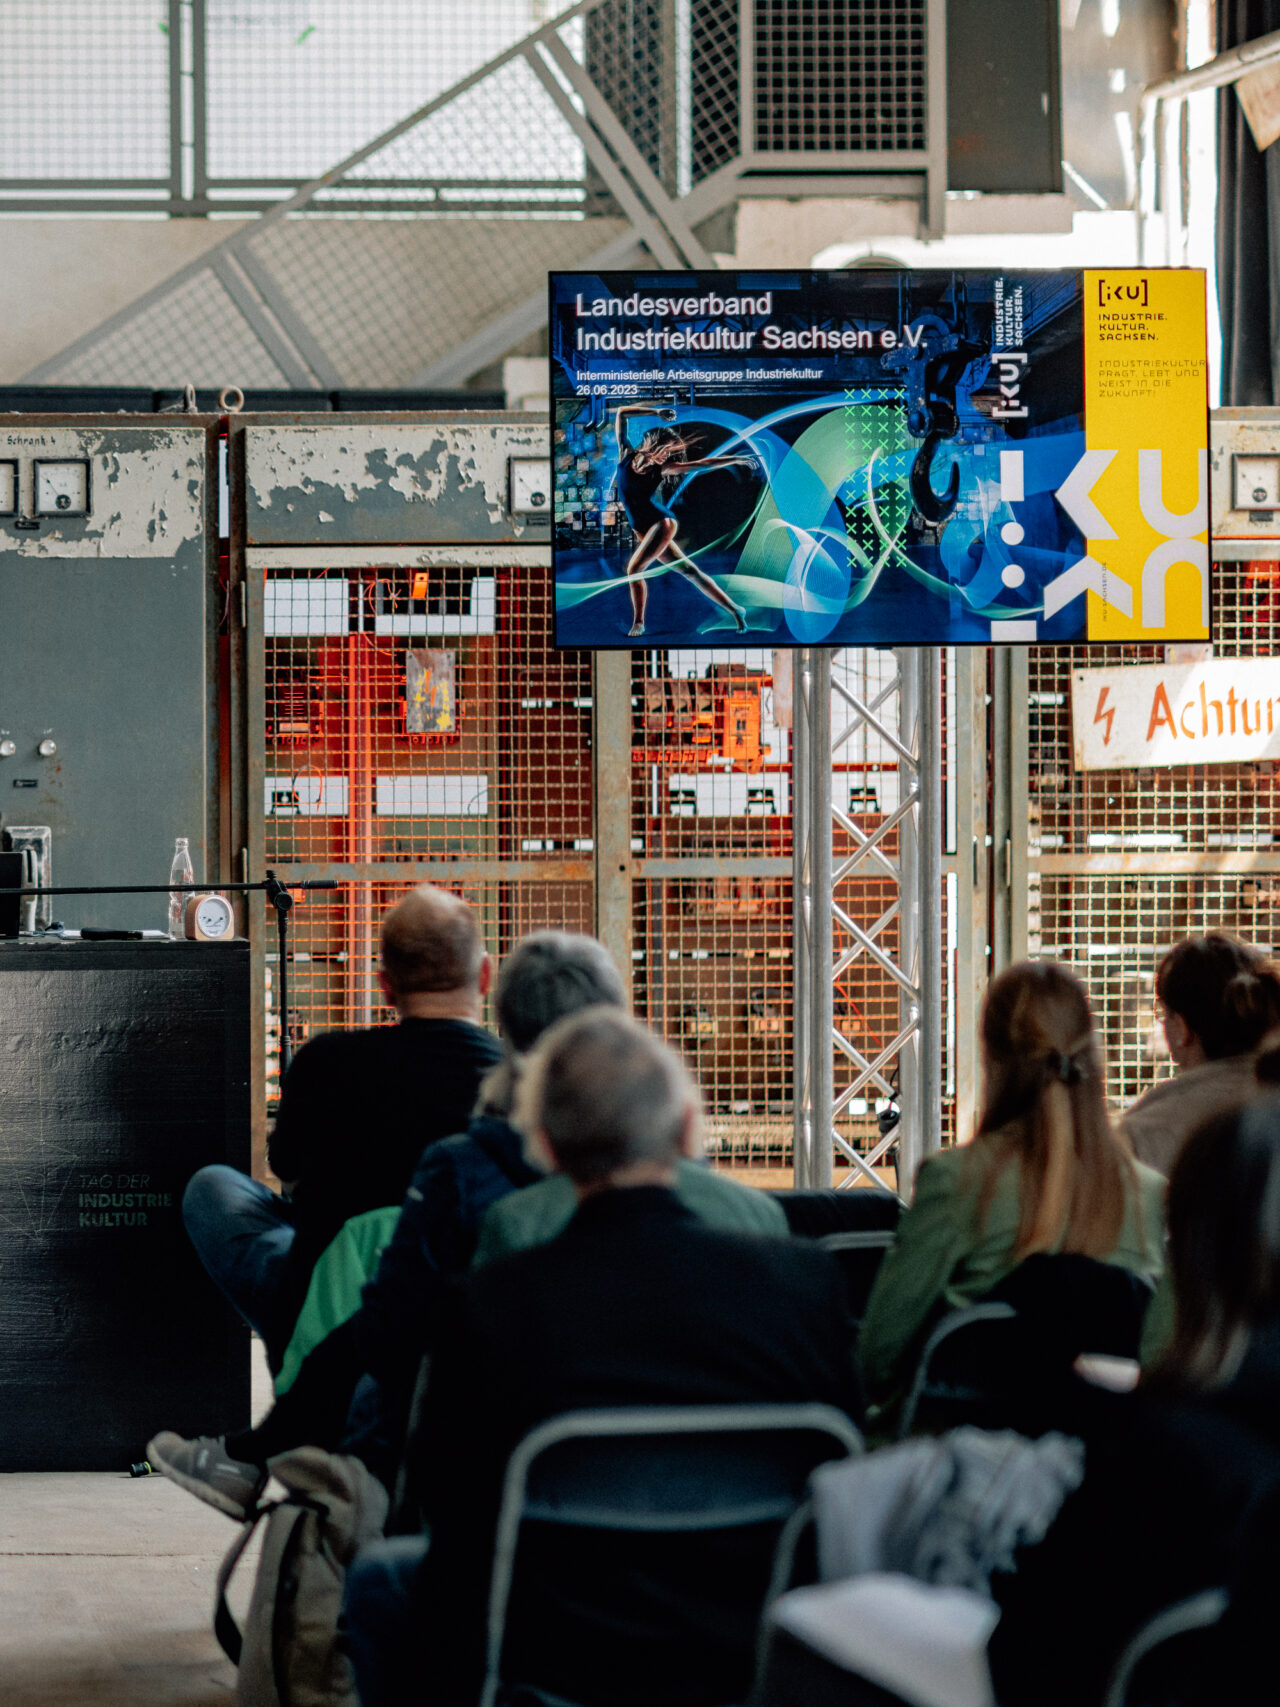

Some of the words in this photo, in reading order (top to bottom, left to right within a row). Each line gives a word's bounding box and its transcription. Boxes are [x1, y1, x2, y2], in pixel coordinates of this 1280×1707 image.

[576, 292, 772, 317] Landesverband
[1099, 313, 1168, 321] INDUSTRIE.
[577, 326, 756, 351] Industriekultur
[762, 325, 872, 349] Sachsen
[880, 324, 928, 348] e.V.
[1099, 333, 1159, 341] SACHSEN.
[576, 369, 665, 381] Interministerielle
[667, 369, 743, 383] Arbeitsgruppe
[746, 368, 823, 380] Industriekultur
[576, 384, 638, 396] 26.06.2023
[7, 435, 46, 446] Schrank
[80, 1174, 113, 1189] TAG
[116, 1174, 151, 1189] DER
[79, 1193, 173, 1207] INDUSTRIE
[79, 1212, 148, 1227] KULTUR
